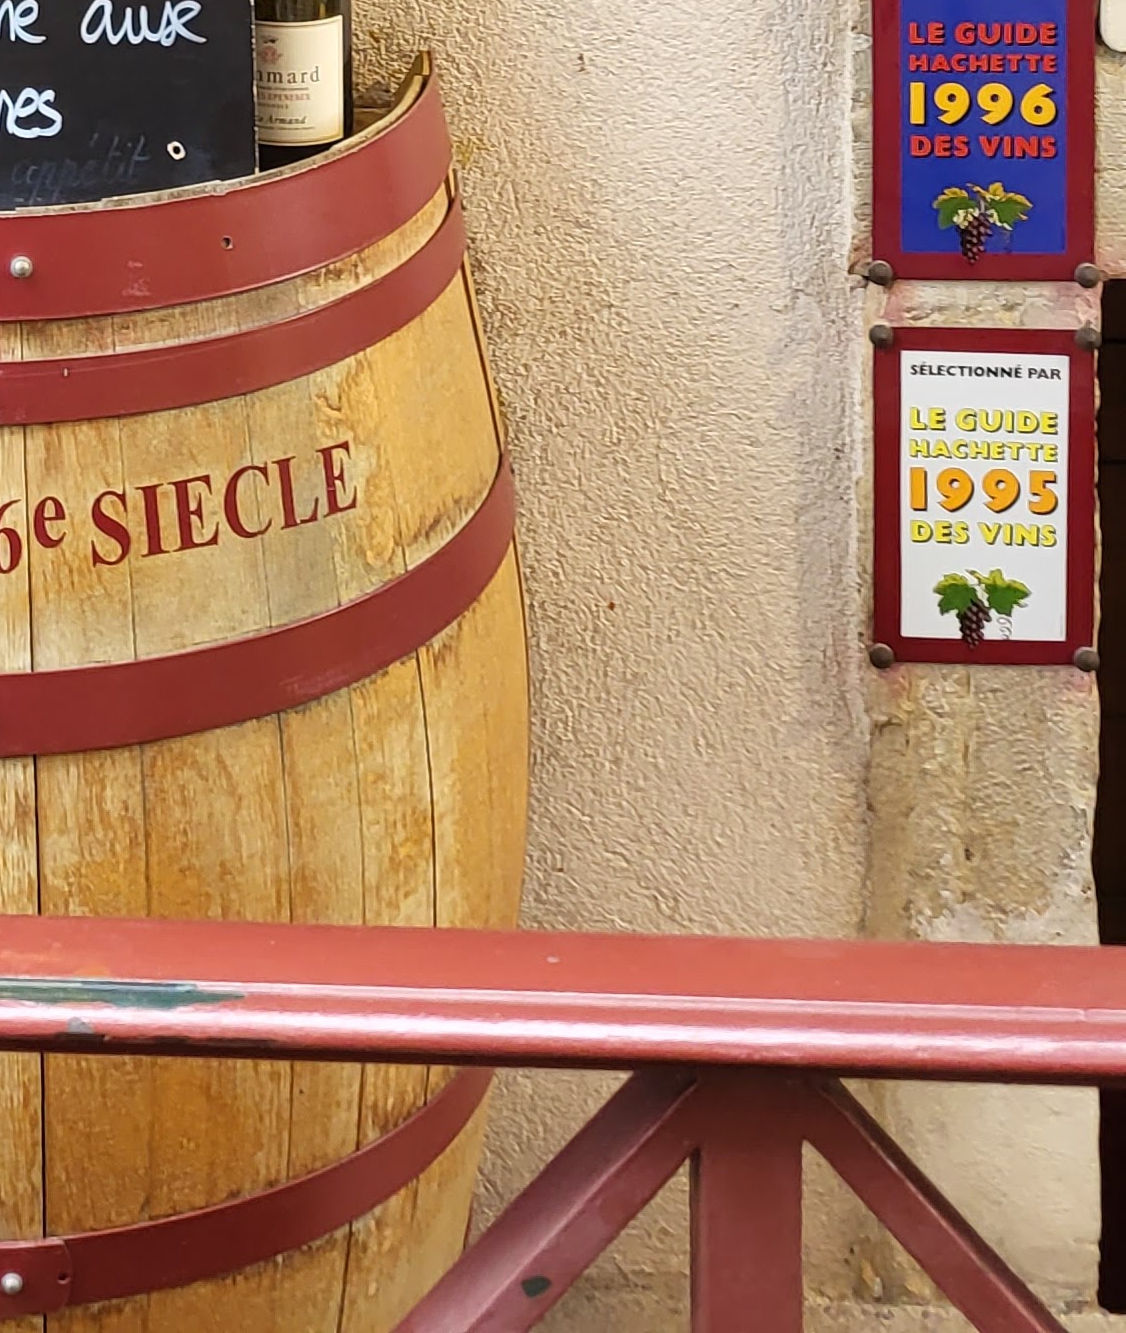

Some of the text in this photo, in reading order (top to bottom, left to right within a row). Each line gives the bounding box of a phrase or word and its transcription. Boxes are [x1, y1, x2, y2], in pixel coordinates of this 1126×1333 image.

[908, 22, 1057, 45] LE GUIDE
[909, 54, 1057, 72] HACHETTE
[257, 66, 321, 84] mard
[909, 82, 1057, 126] 1996
[909, 135, 1057, 158] DES VINS
[910, 361, 1061, 380] SÉLECTIONNÉ PAR
[909, 407, 1058, 434] LE GUIDE
[909, 439, 1058, 462] HACHETTE
[909, 467, 1058, 514] 1995
[92, 440, 358, 566] SIECLE
[910, 520, 1057, 547] DES VINS
